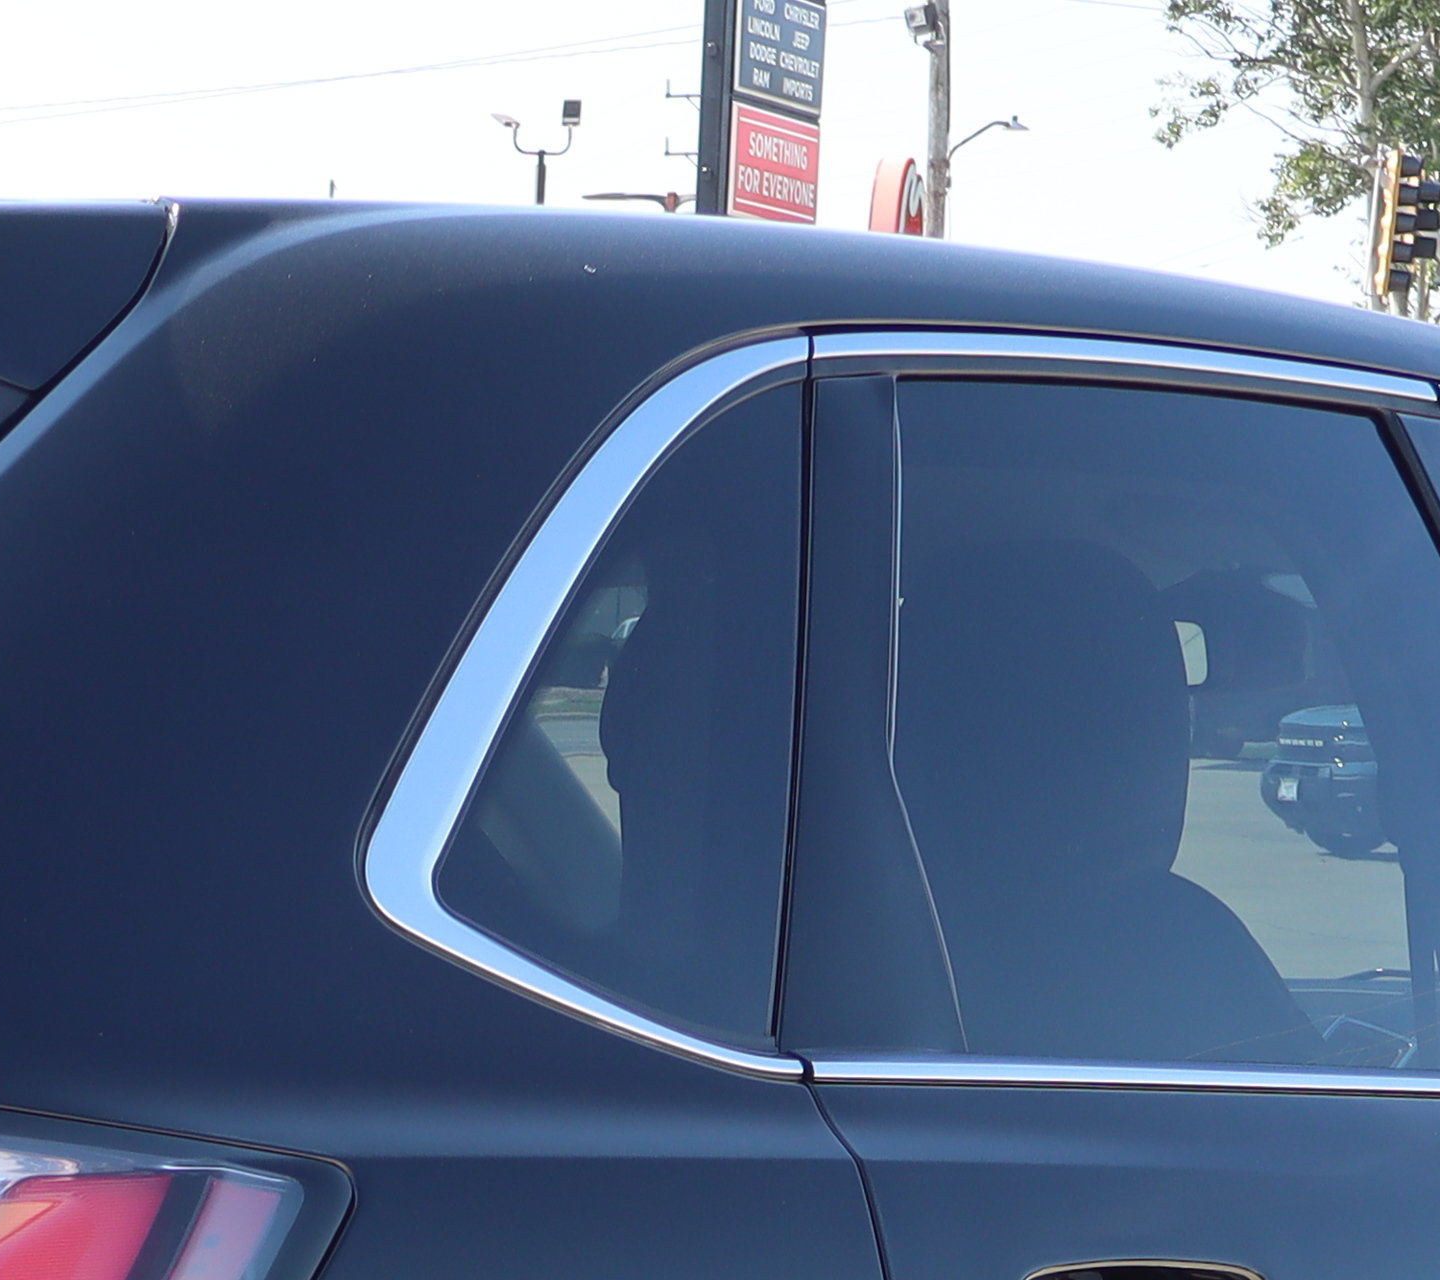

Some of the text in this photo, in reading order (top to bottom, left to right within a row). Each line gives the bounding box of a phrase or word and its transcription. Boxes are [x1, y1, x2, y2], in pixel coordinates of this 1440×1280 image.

[748, 15, 781, 41] LINCOLN
[784, 2, 820, 30] CHRYSLER
[749, 41, 777, 66] DODGE
[792, 30, 810, 51] JEEP
[780, 51, 820, 78] CHEVROLET
[753, 67, 771, 89] RAM
[783, 77, 813, 101] IMPORTS
[748, 131, 808, 171] SOMETHING
[737, 164, 815, 208] FOR EVERYONE
